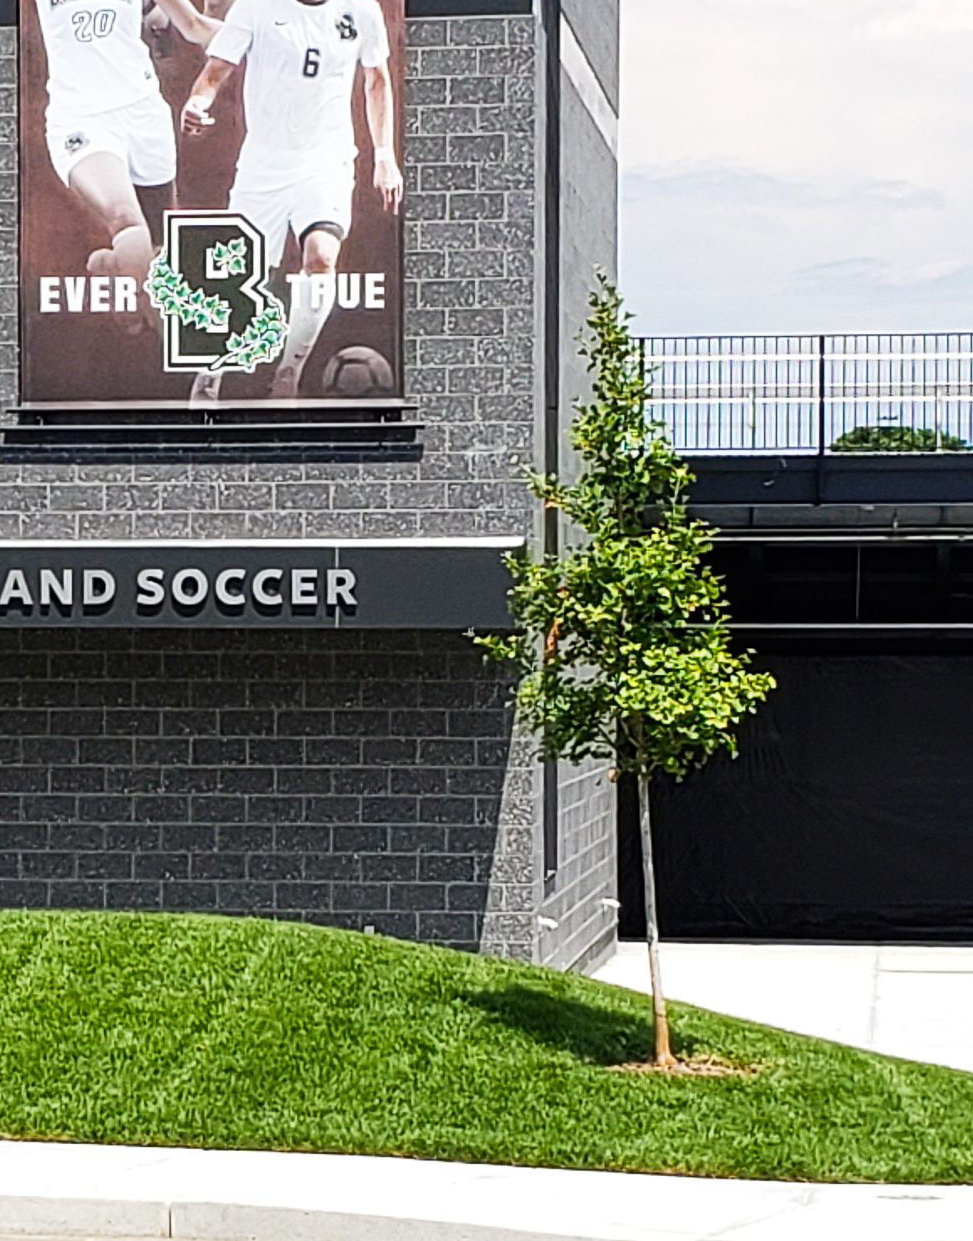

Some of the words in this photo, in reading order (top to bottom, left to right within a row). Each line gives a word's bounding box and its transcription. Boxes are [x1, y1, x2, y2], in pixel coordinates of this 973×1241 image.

[71, 9, 116, 43] 20
[303, 48, 320, 78] 6
[39, 276, 137, 313] EVER
[286, 273, 386, 310] TRUE
[136, 568, 358, 605] SOCCER
